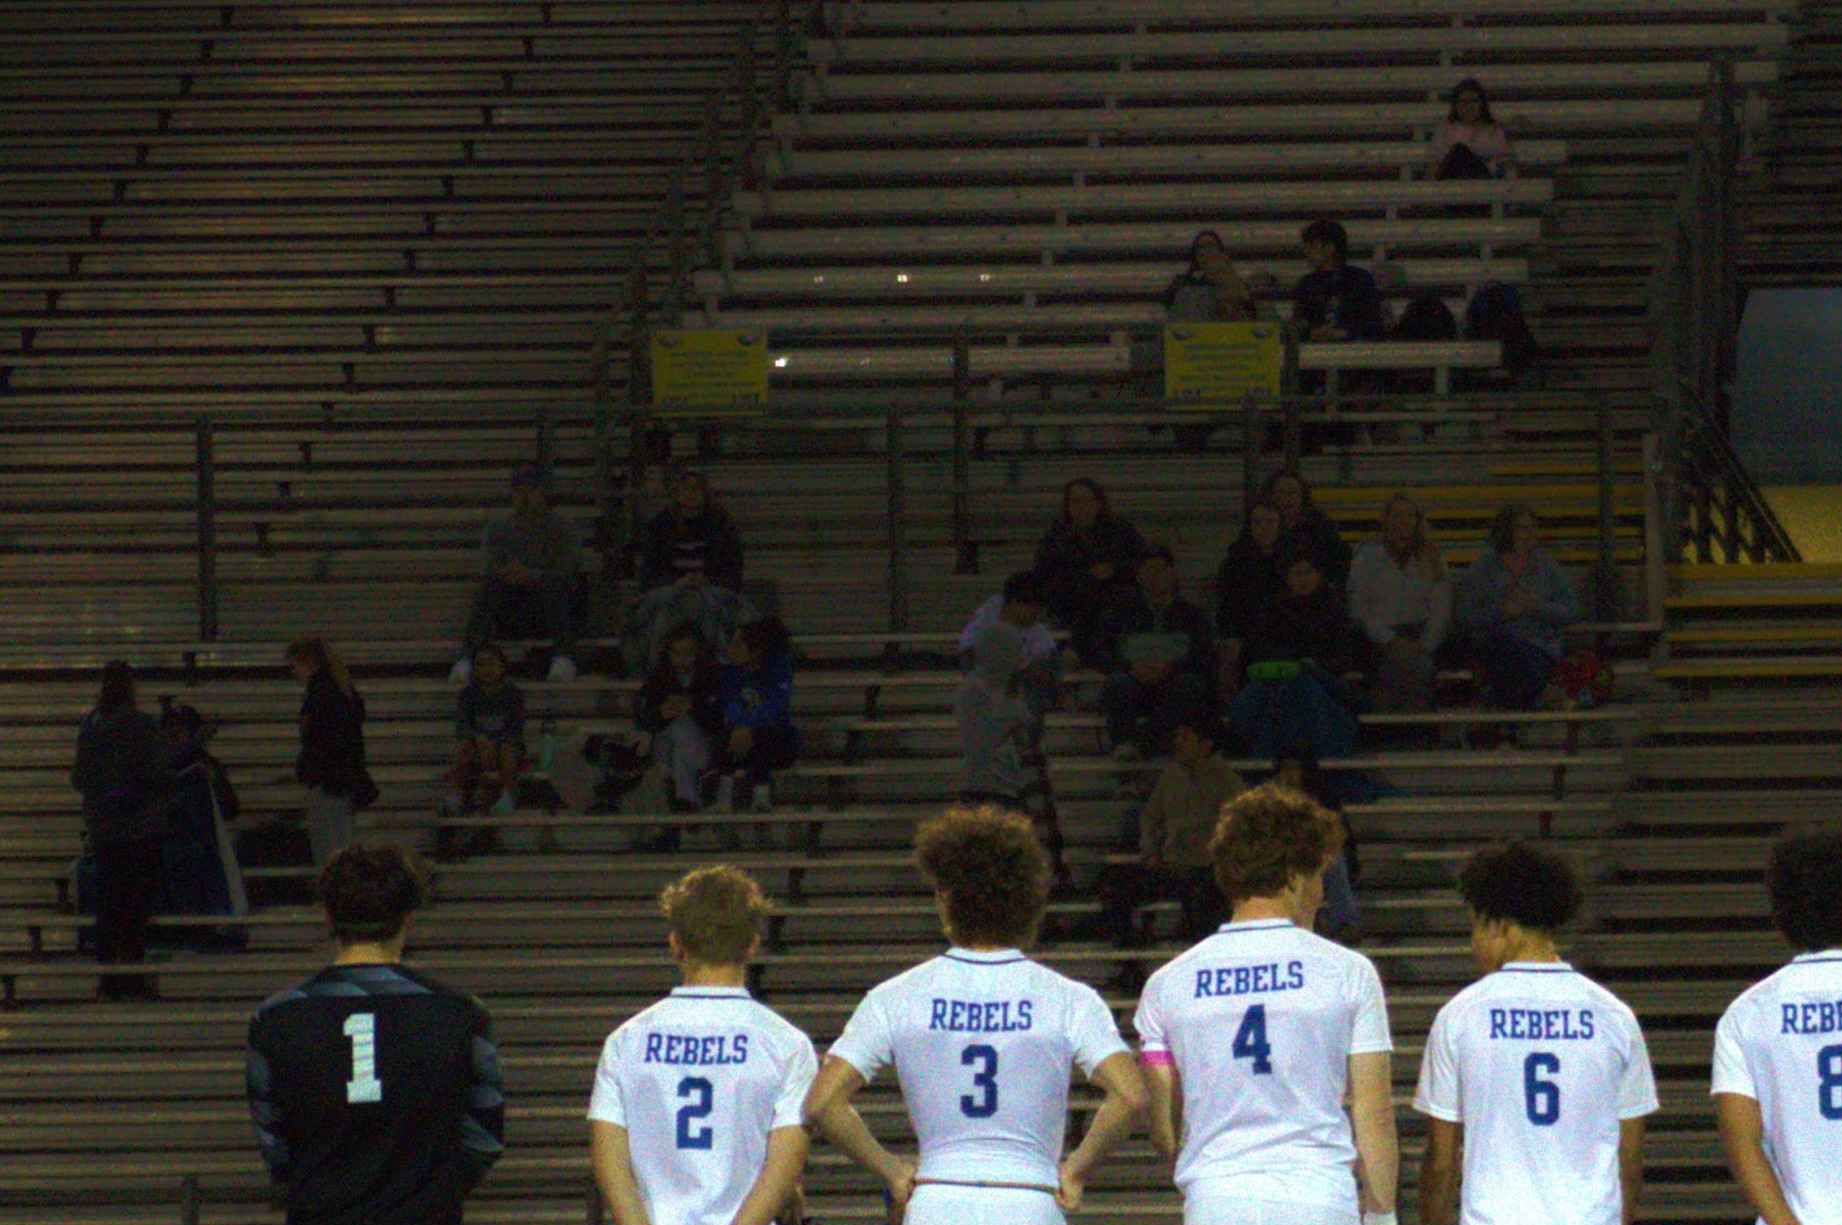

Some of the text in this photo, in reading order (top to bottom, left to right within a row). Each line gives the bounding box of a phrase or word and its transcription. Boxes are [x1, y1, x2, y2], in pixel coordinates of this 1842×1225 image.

[1194, 961, 1304, 999] REBELS
[645, 1033, 748, 1065] REBELS
[930, 998, 1032, 1033] REBELS
[1233, 1004, 1273, 1074] 4
[1490, 1008, 1596, 1040] REBELS
[343, 1013, 382, 1104] 1
[961, 1045, 998, 1114] 3
[1525, 1053, 1560, 1126] 6
[675, 1076, 714, 1150] 2
